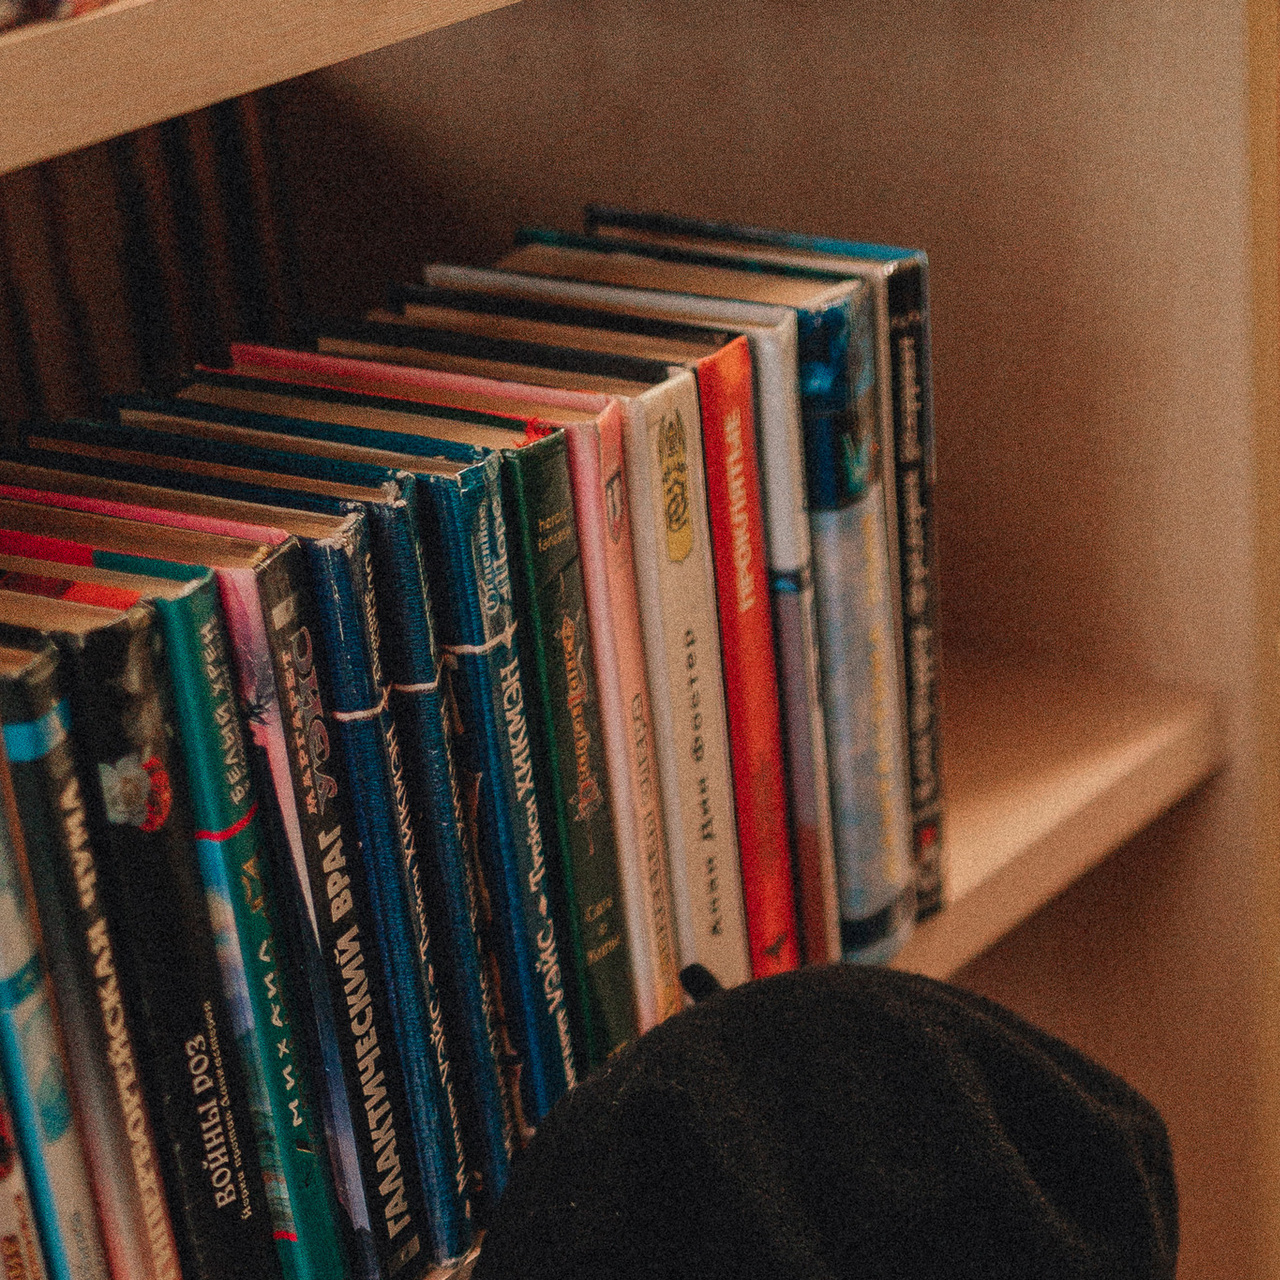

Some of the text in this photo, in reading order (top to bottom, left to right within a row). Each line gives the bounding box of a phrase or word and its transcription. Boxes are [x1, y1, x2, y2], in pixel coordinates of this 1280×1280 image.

[198, 620, 226, 697] ХРЕН
[498, 656, 534, 800] ХИКМЭН
[56, 775, 99, 909] ЧУМА
[255, 937, 302, 1127] МИХАИЛ
[317, 824, 409, 1239] ГАЛАКТИЧЕСКИЙ ВРАГ
[536, 917, 563, 1013] УЭЙС
[184, 1032, 237, 1208] ВОЙНЫ РОЗ
